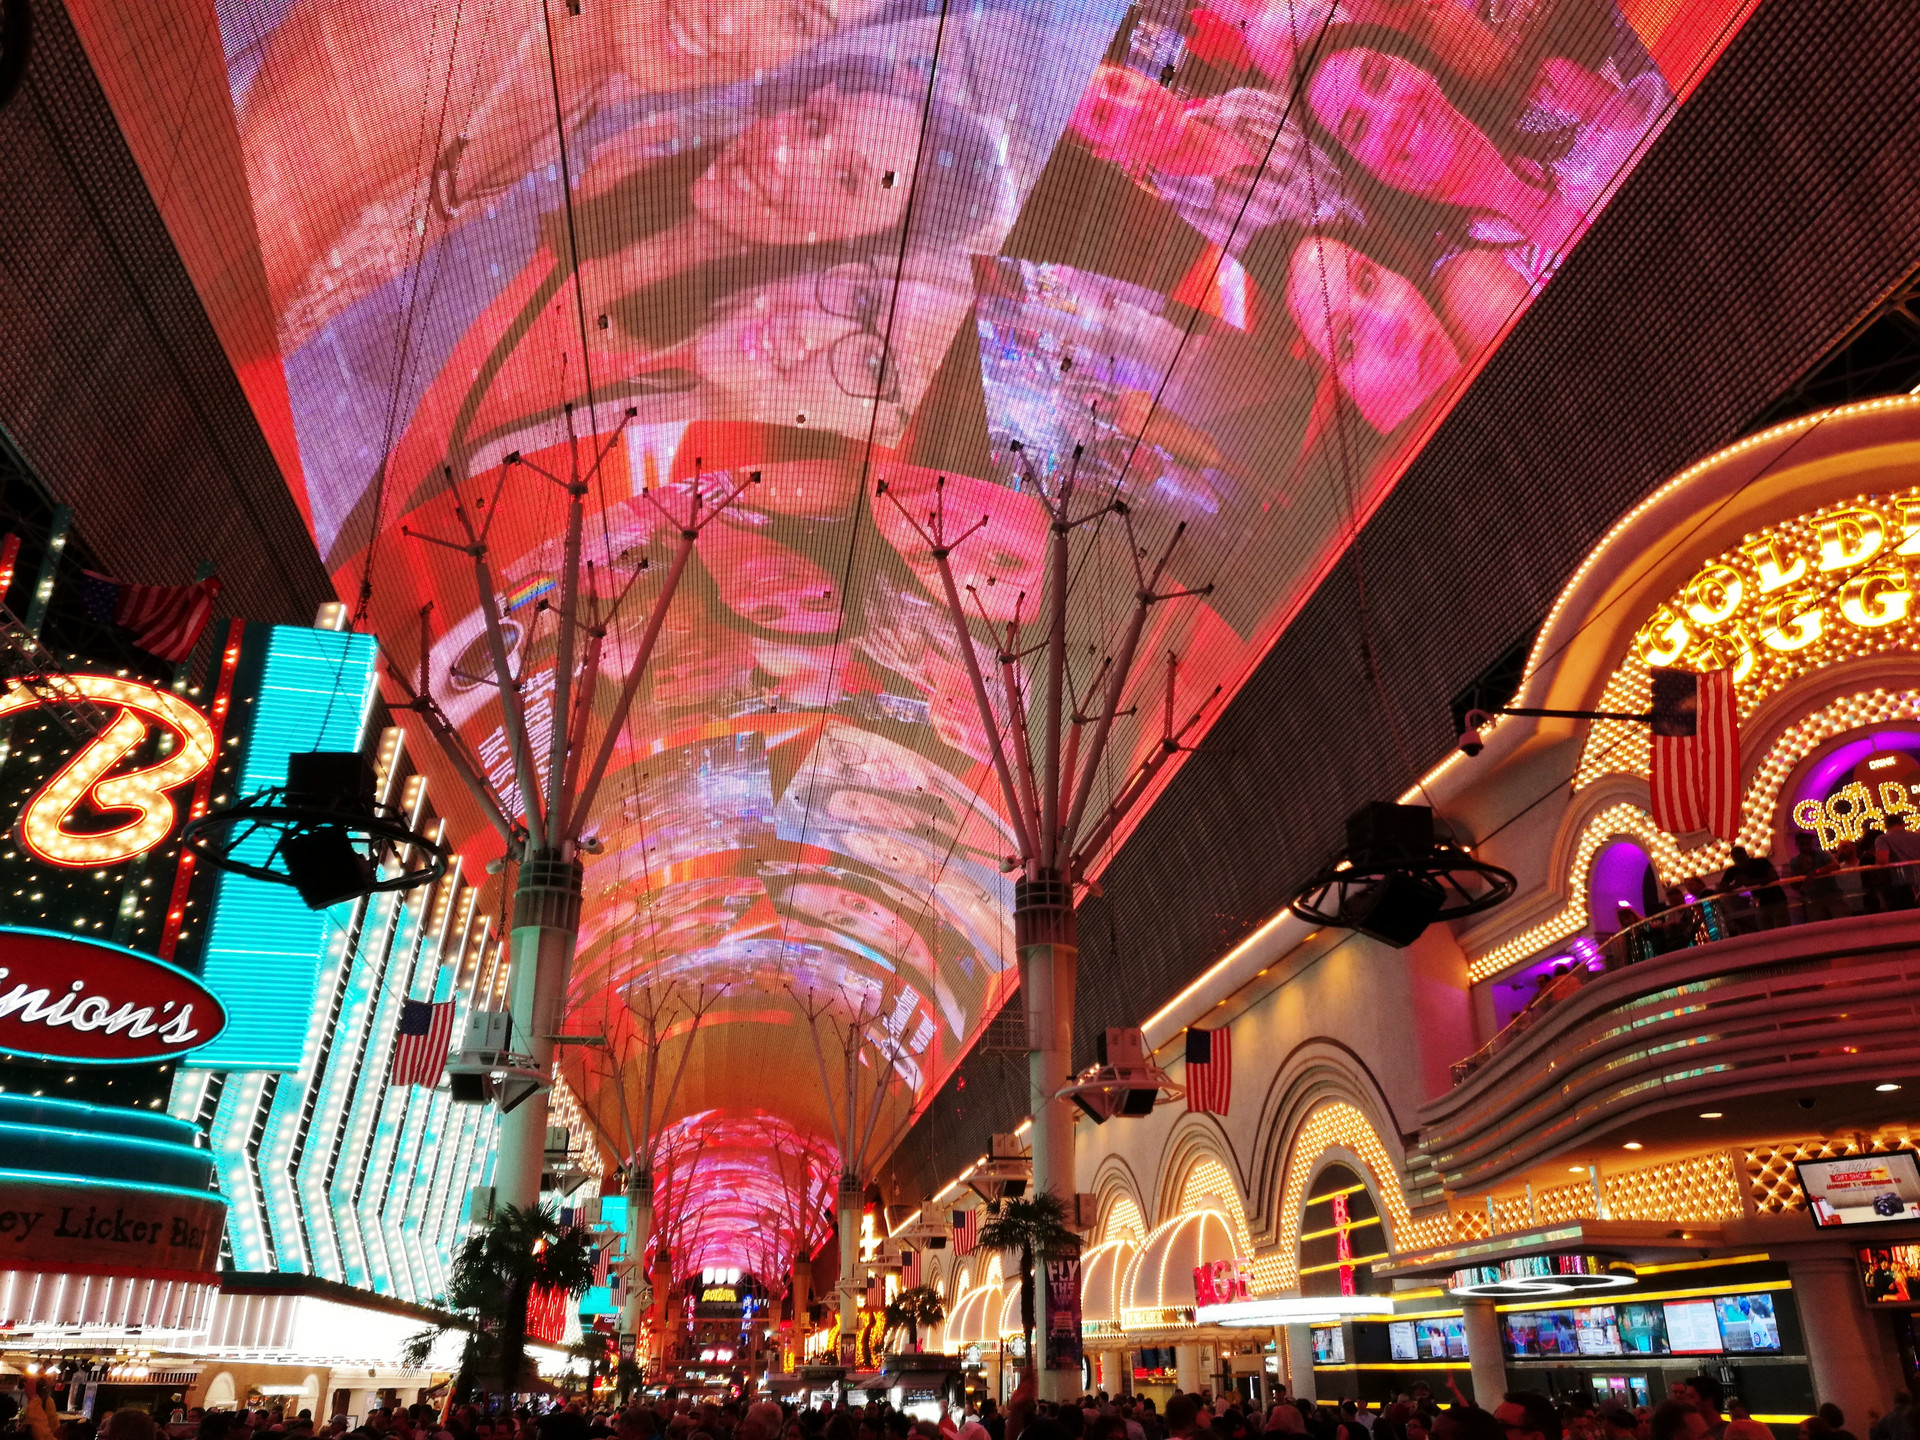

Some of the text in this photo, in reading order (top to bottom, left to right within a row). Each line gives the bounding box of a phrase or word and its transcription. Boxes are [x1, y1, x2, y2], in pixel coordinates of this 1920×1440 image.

[478, 725, 510, 769] TAG
[1868, 755, 1897, 770] DRINK
[488, 756, 516, 789] US
[54, 1206, 162, 1244] Licker
[1332, 1193, 1356, 1298] BAR
[1050, 1281, 1075, 1294] THE
